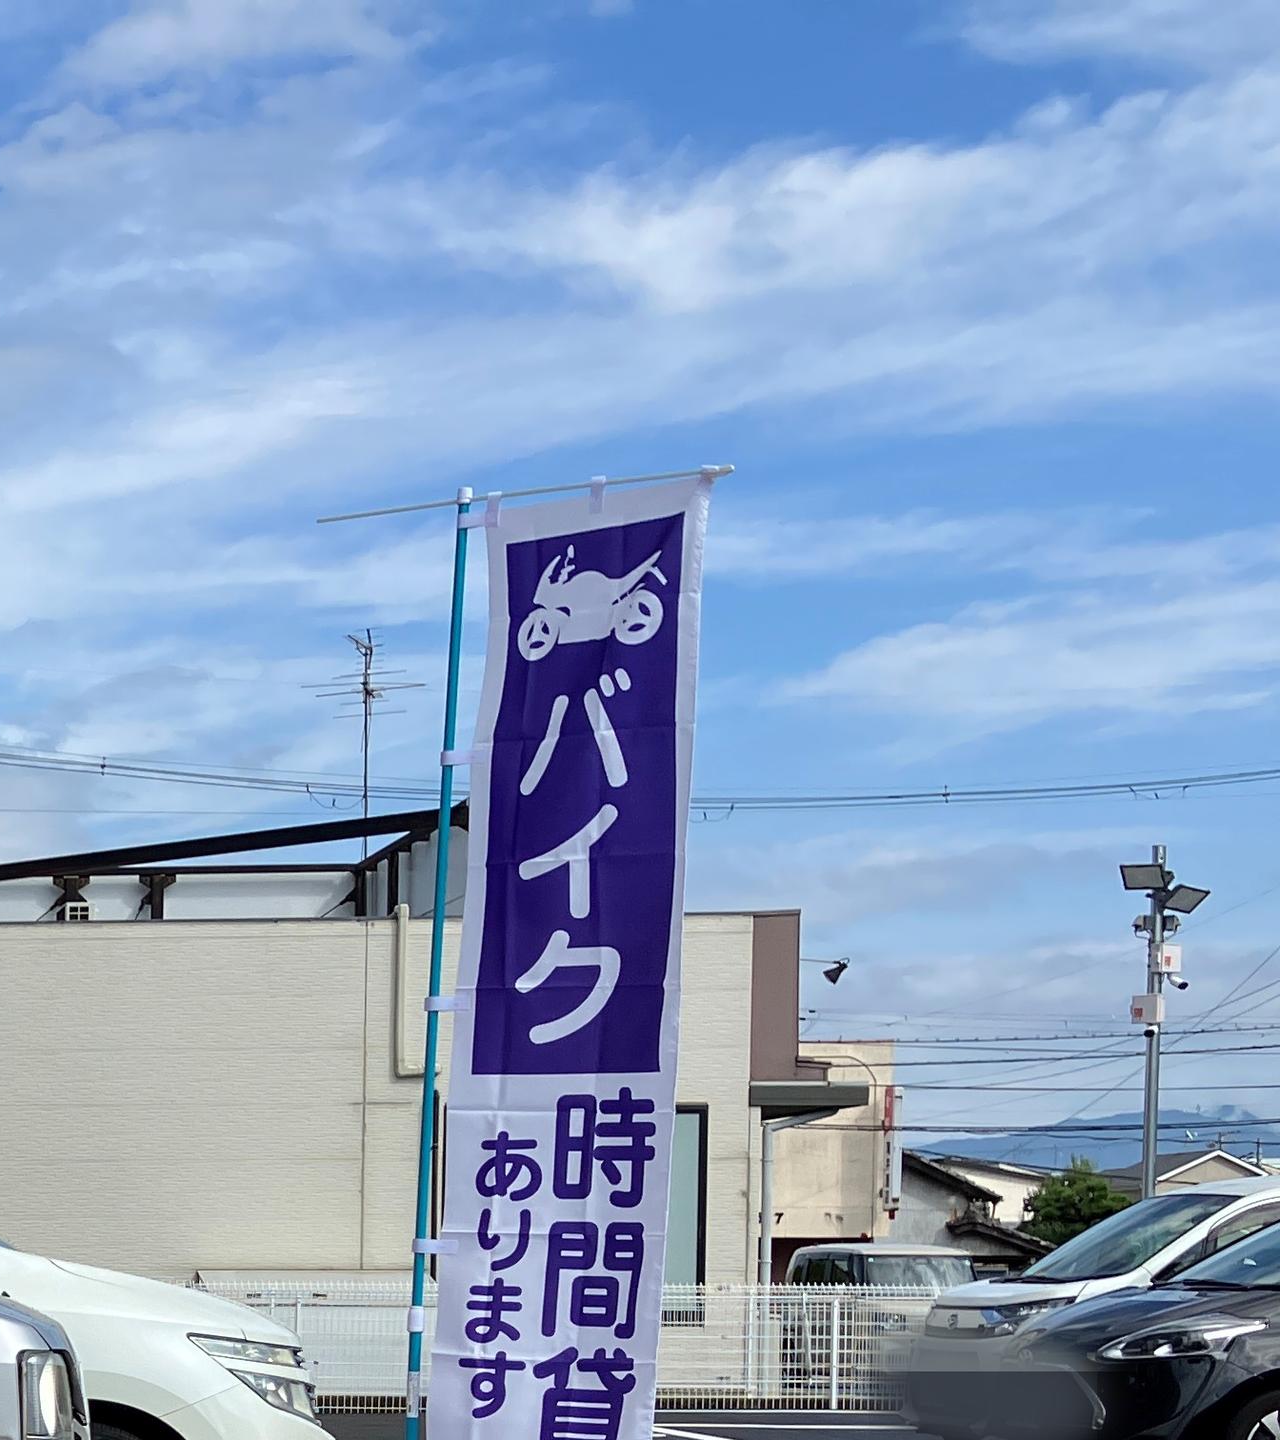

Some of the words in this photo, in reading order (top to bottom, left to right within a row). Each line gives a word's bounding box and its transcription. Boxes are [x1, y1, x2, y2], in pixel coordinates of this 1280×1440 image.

[514, 667, 632, 1045] バイク
[459, 1131, 544, 1419] あります
